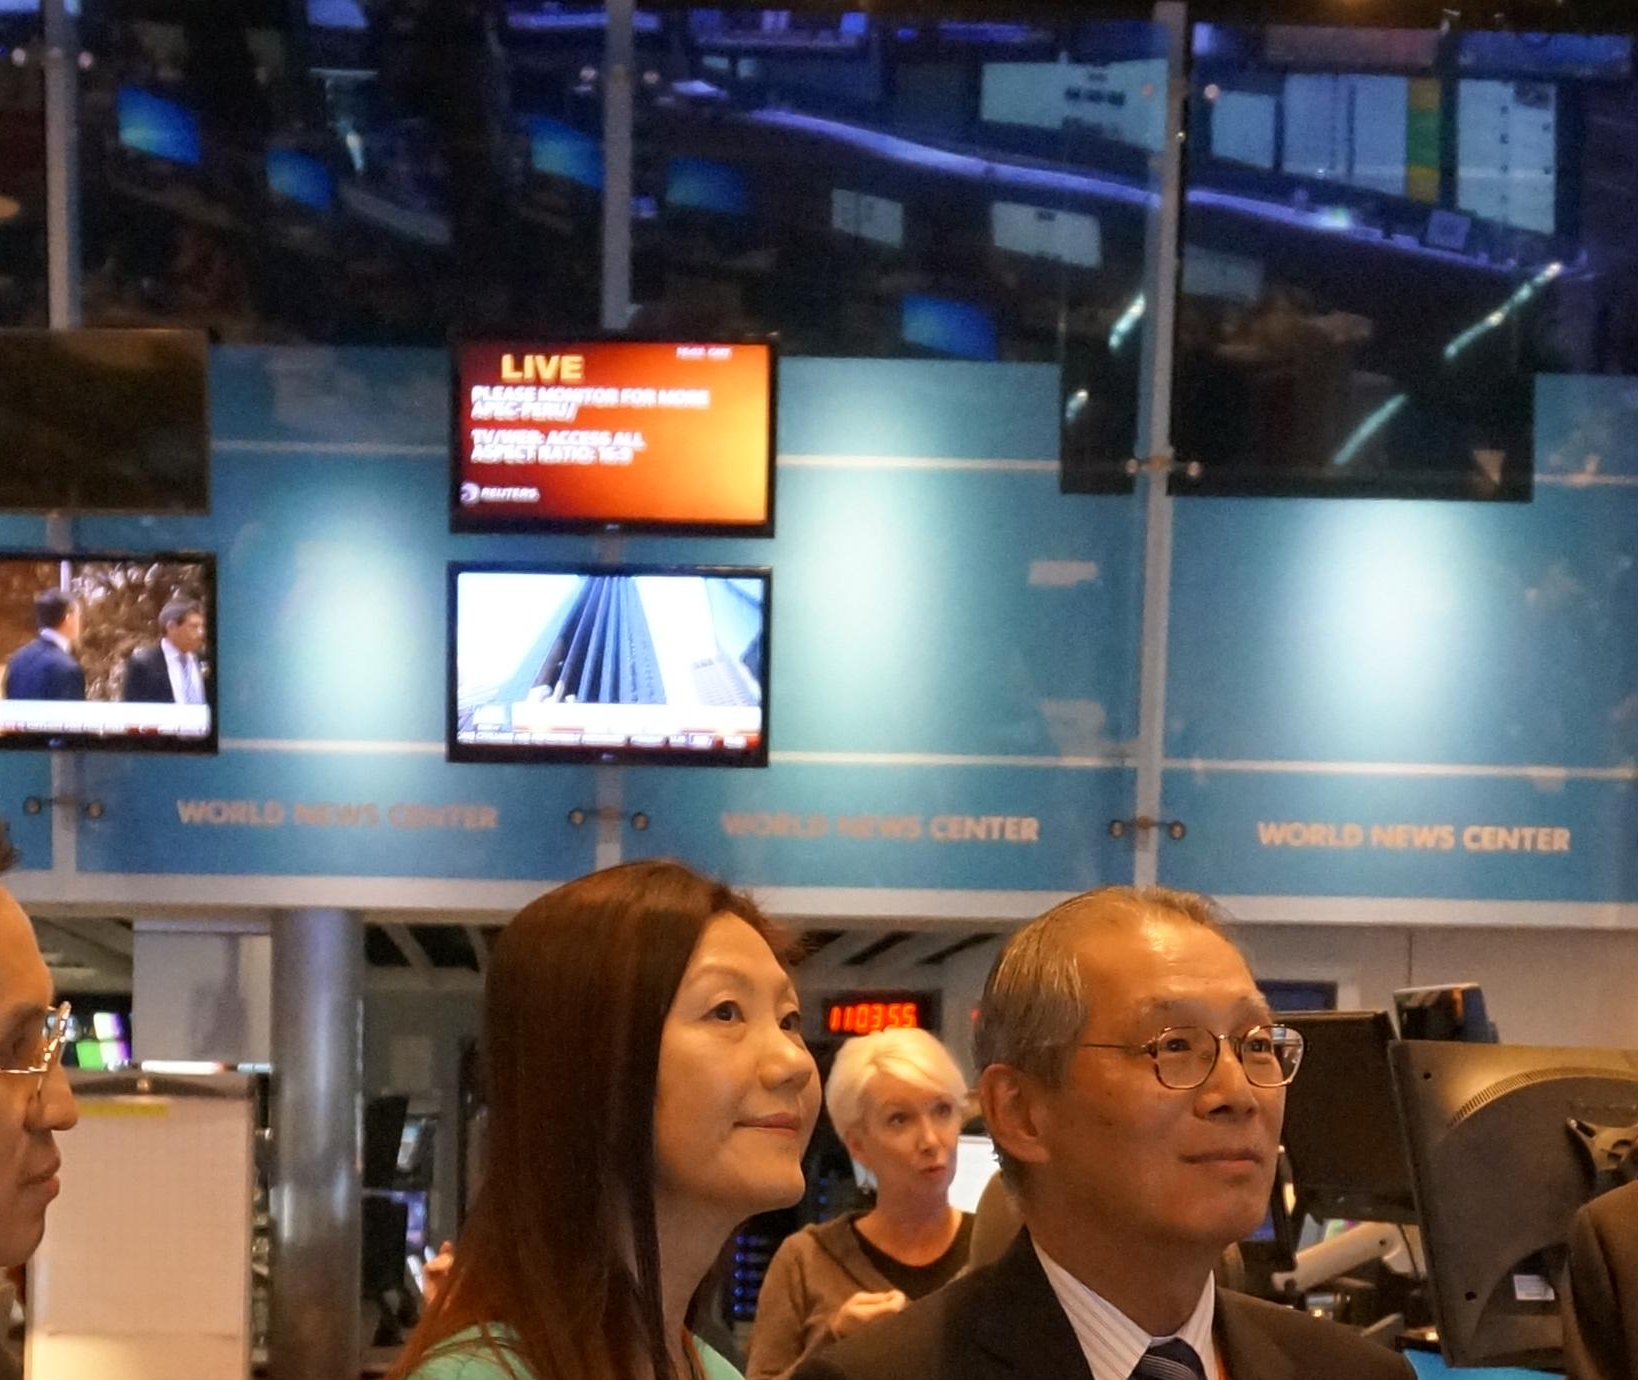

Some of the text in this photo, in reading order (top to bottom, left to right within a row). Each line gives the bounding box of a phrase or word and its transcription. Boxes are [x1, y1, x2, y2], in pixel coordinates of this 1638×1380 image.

[501, 353, 585, 383] LIVE
[471, 385, 710, 409] PLEASE MONITOR FOR MORE
[546, 431, 613, 448] ACCESS
[471, 446, 537, 464] ASPECT
[480, 487, 540, 501] REUTERS
[177, 799, 499, 829] WORLD NEWS CENTER
[721, 811, 1040, 842] WORLD NEWS CENTER
[1258, 822, 1571, 852] WORLD NEWS CENTER
